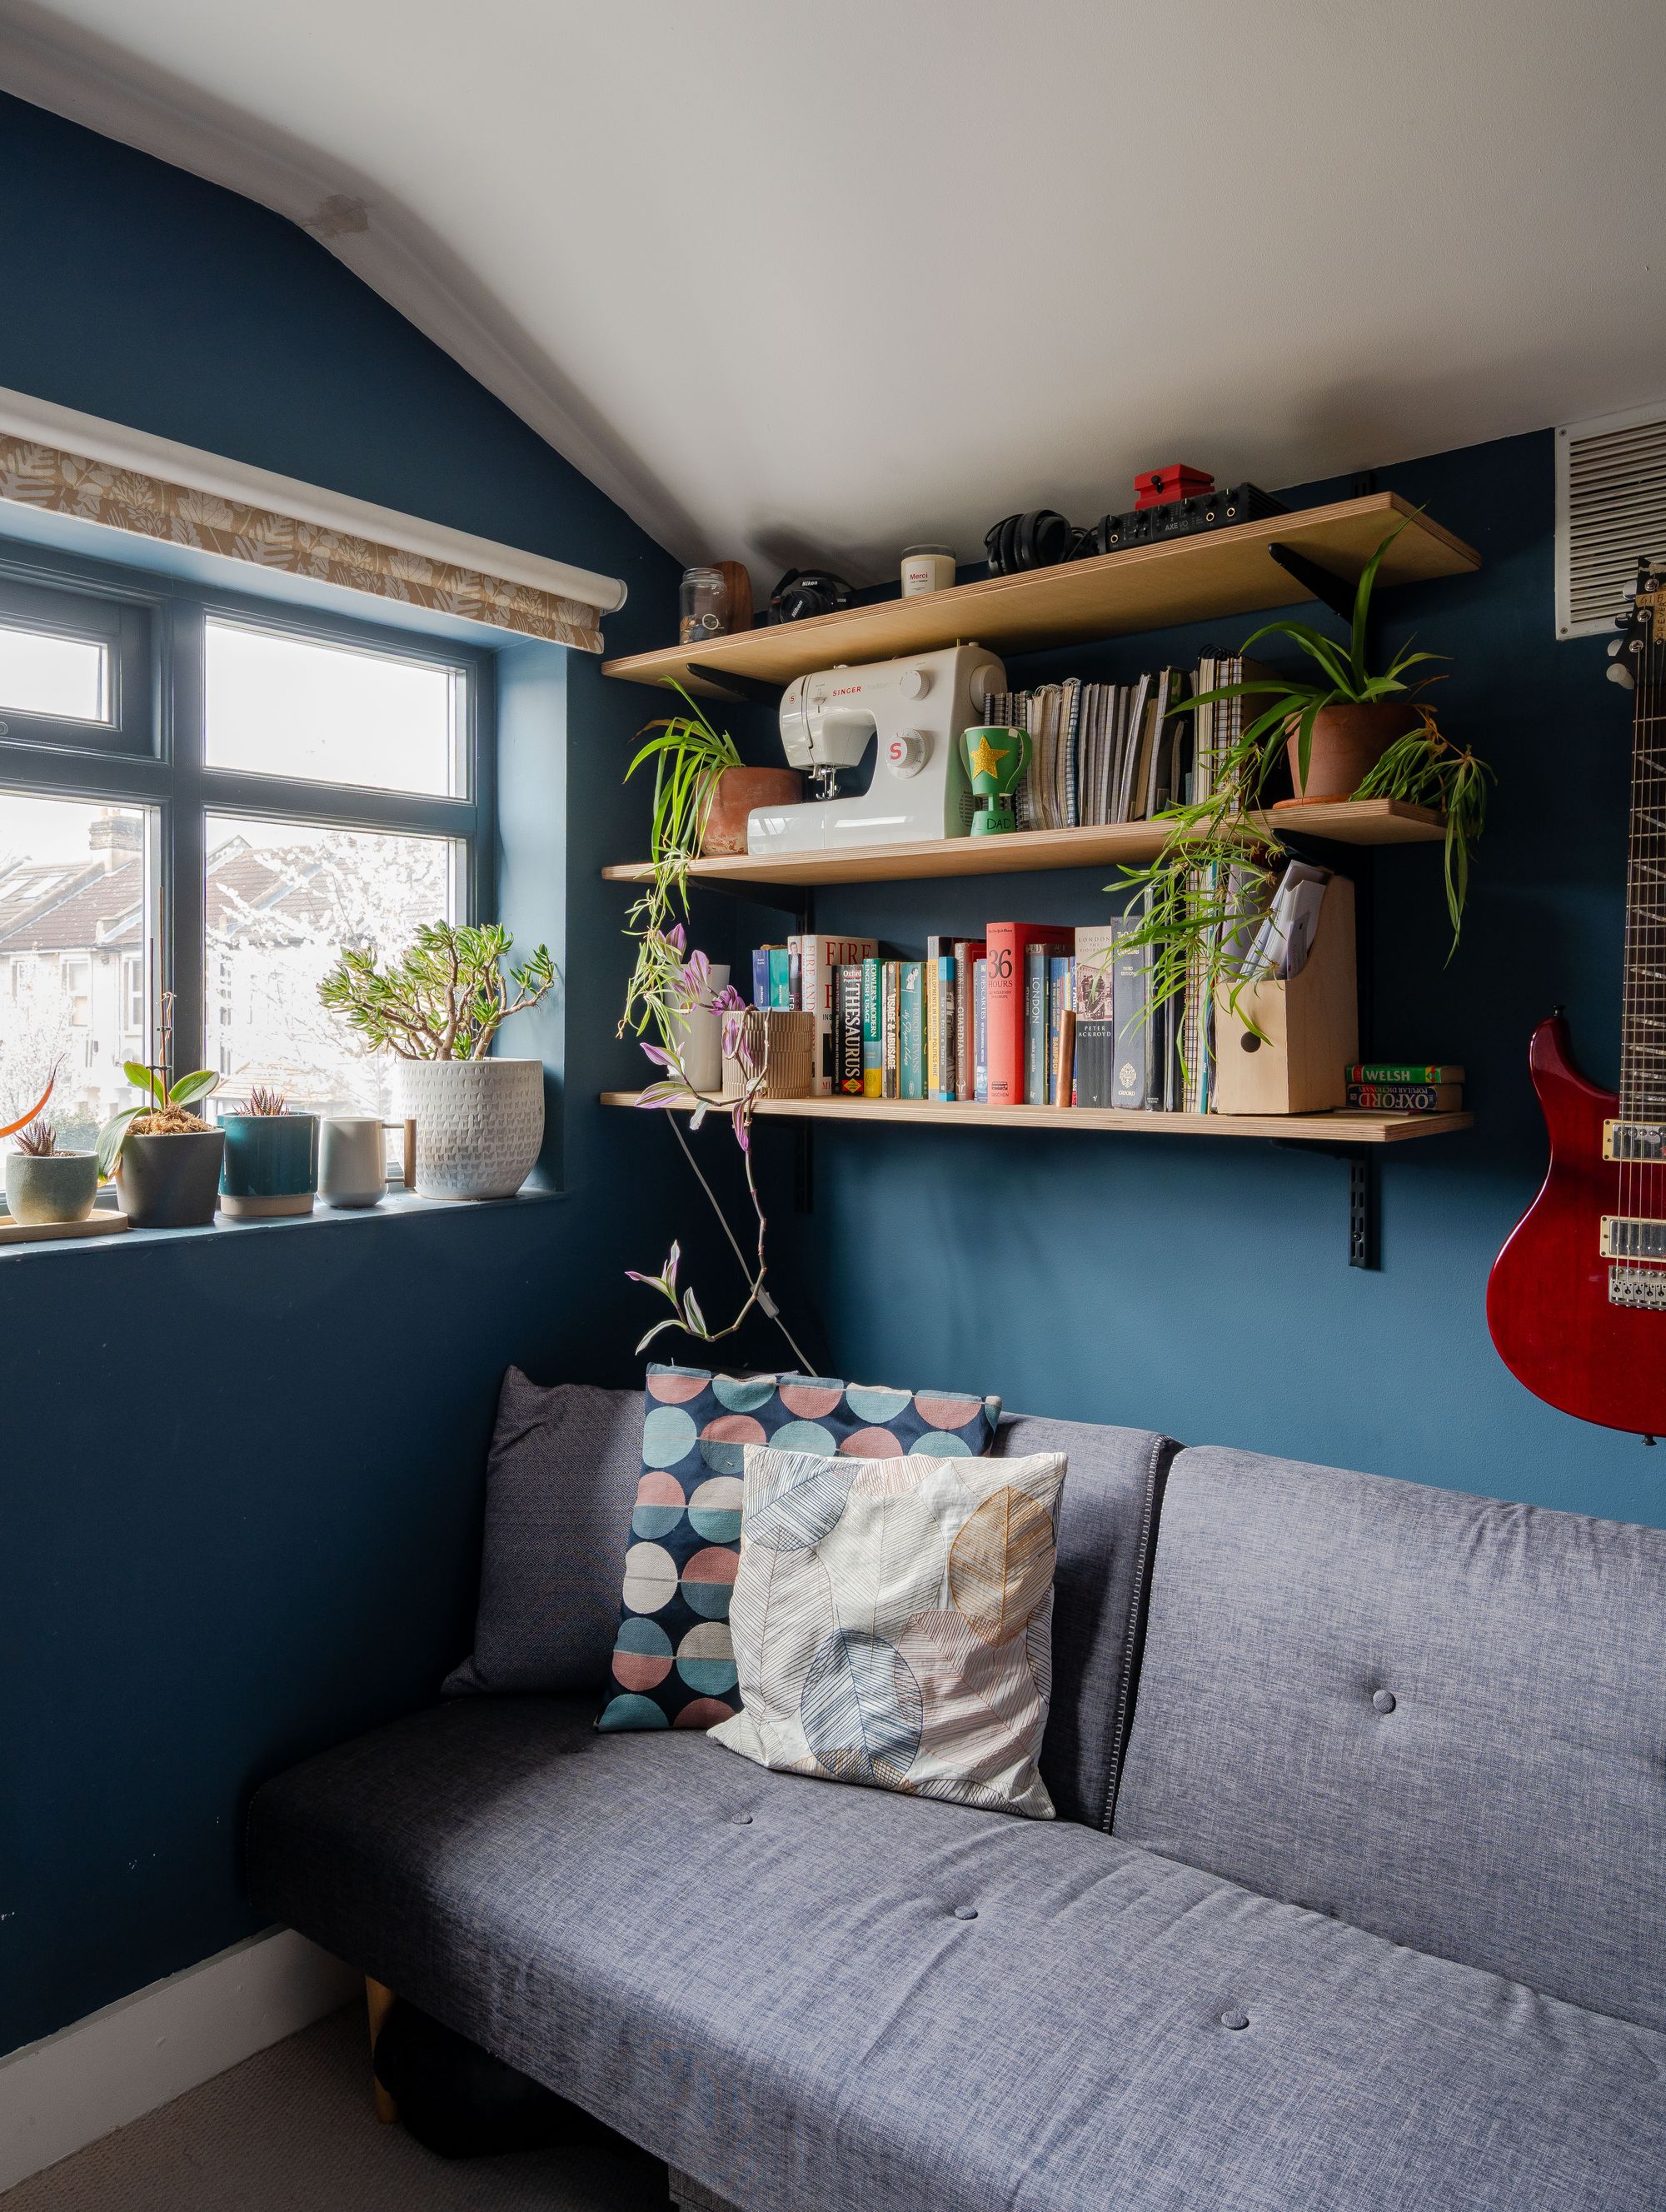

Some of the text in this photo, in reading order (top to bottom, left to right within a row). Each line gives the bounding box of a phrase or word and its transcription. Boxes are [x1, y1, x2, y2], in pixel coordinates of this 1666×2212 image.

[1165, 523, 1178, 532] AXE
[791, 600, 803, 618] Nikon
[833, 686, 862, 697] SINGER
[890, 742, 902, 760] S
[987, 818, 1011, 830] DAD
[825, 941, 871, 966] FIRE
[989, 949, 1012, 979] 36
[806, 946, 815, 1011] FIRE AND
[887, 995, 896, 1022] USAGE
[845, 982, 860, 1077] THESAURUS
[902, 1022, 912, 1045] Paper
[887, 1032, 896, 1070] ABUSAGE
[1366, 1070, 1410, 1081] WELSH
[1358, 1093, 1429, 1109] OXFORD
